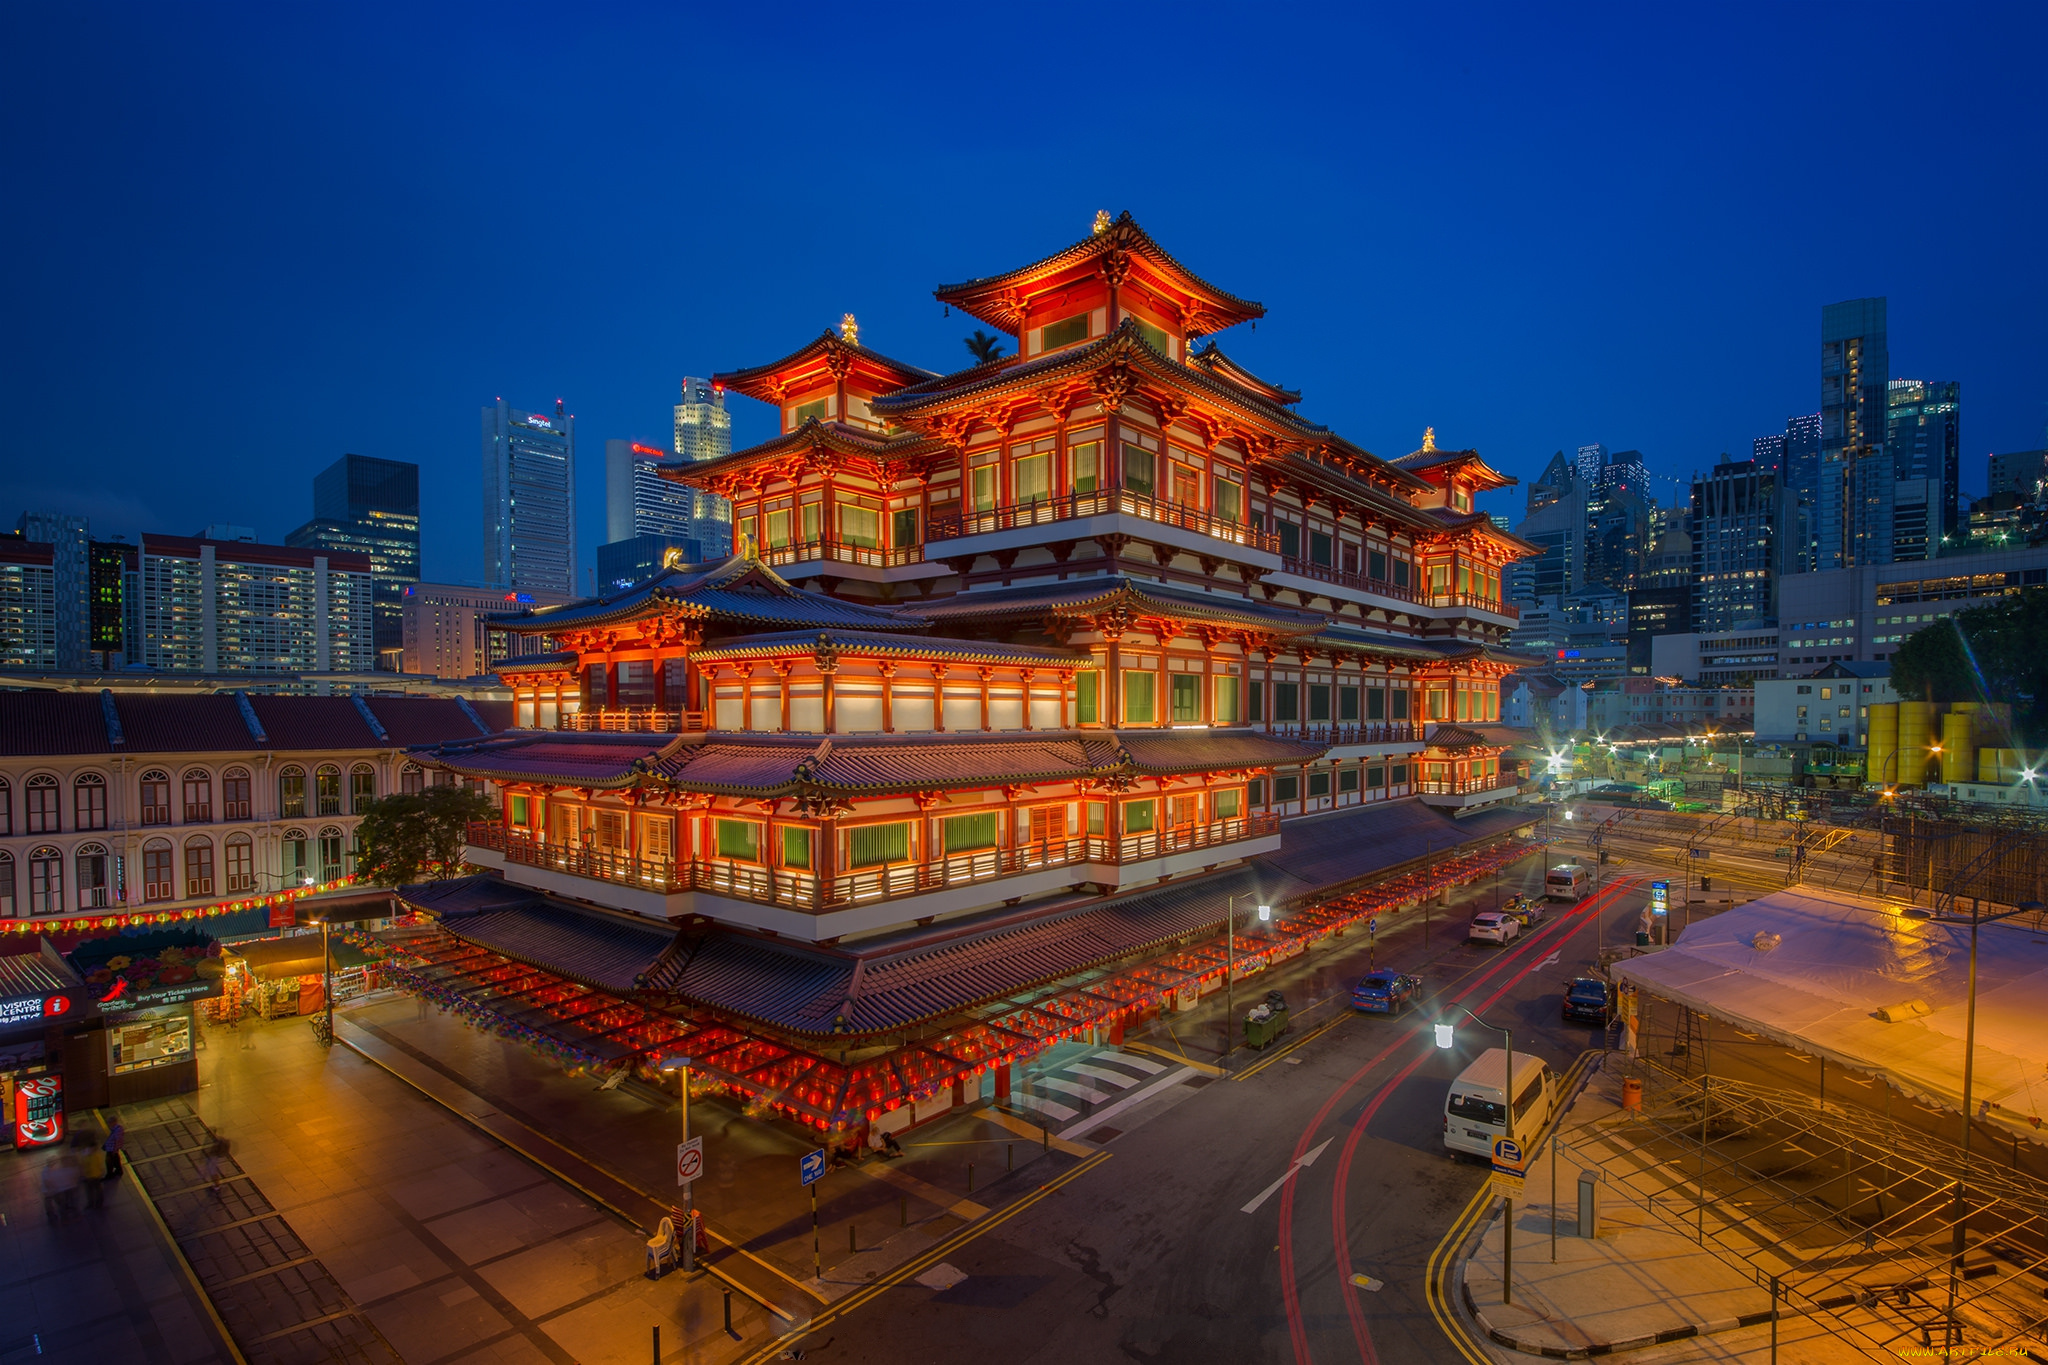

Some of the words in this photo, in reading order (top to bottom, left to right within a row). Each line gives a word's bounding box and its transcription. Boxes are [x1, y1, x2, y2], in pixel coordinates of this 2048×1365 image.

[528, 416, 550, 428] Singtel
[167, 988, 191, 997] Tickets
[3, 998, 41, 1010] VISITOR
[3, 1004, 41, 1016] CENTRE
[804, 1173, 813, 1182] ONE
